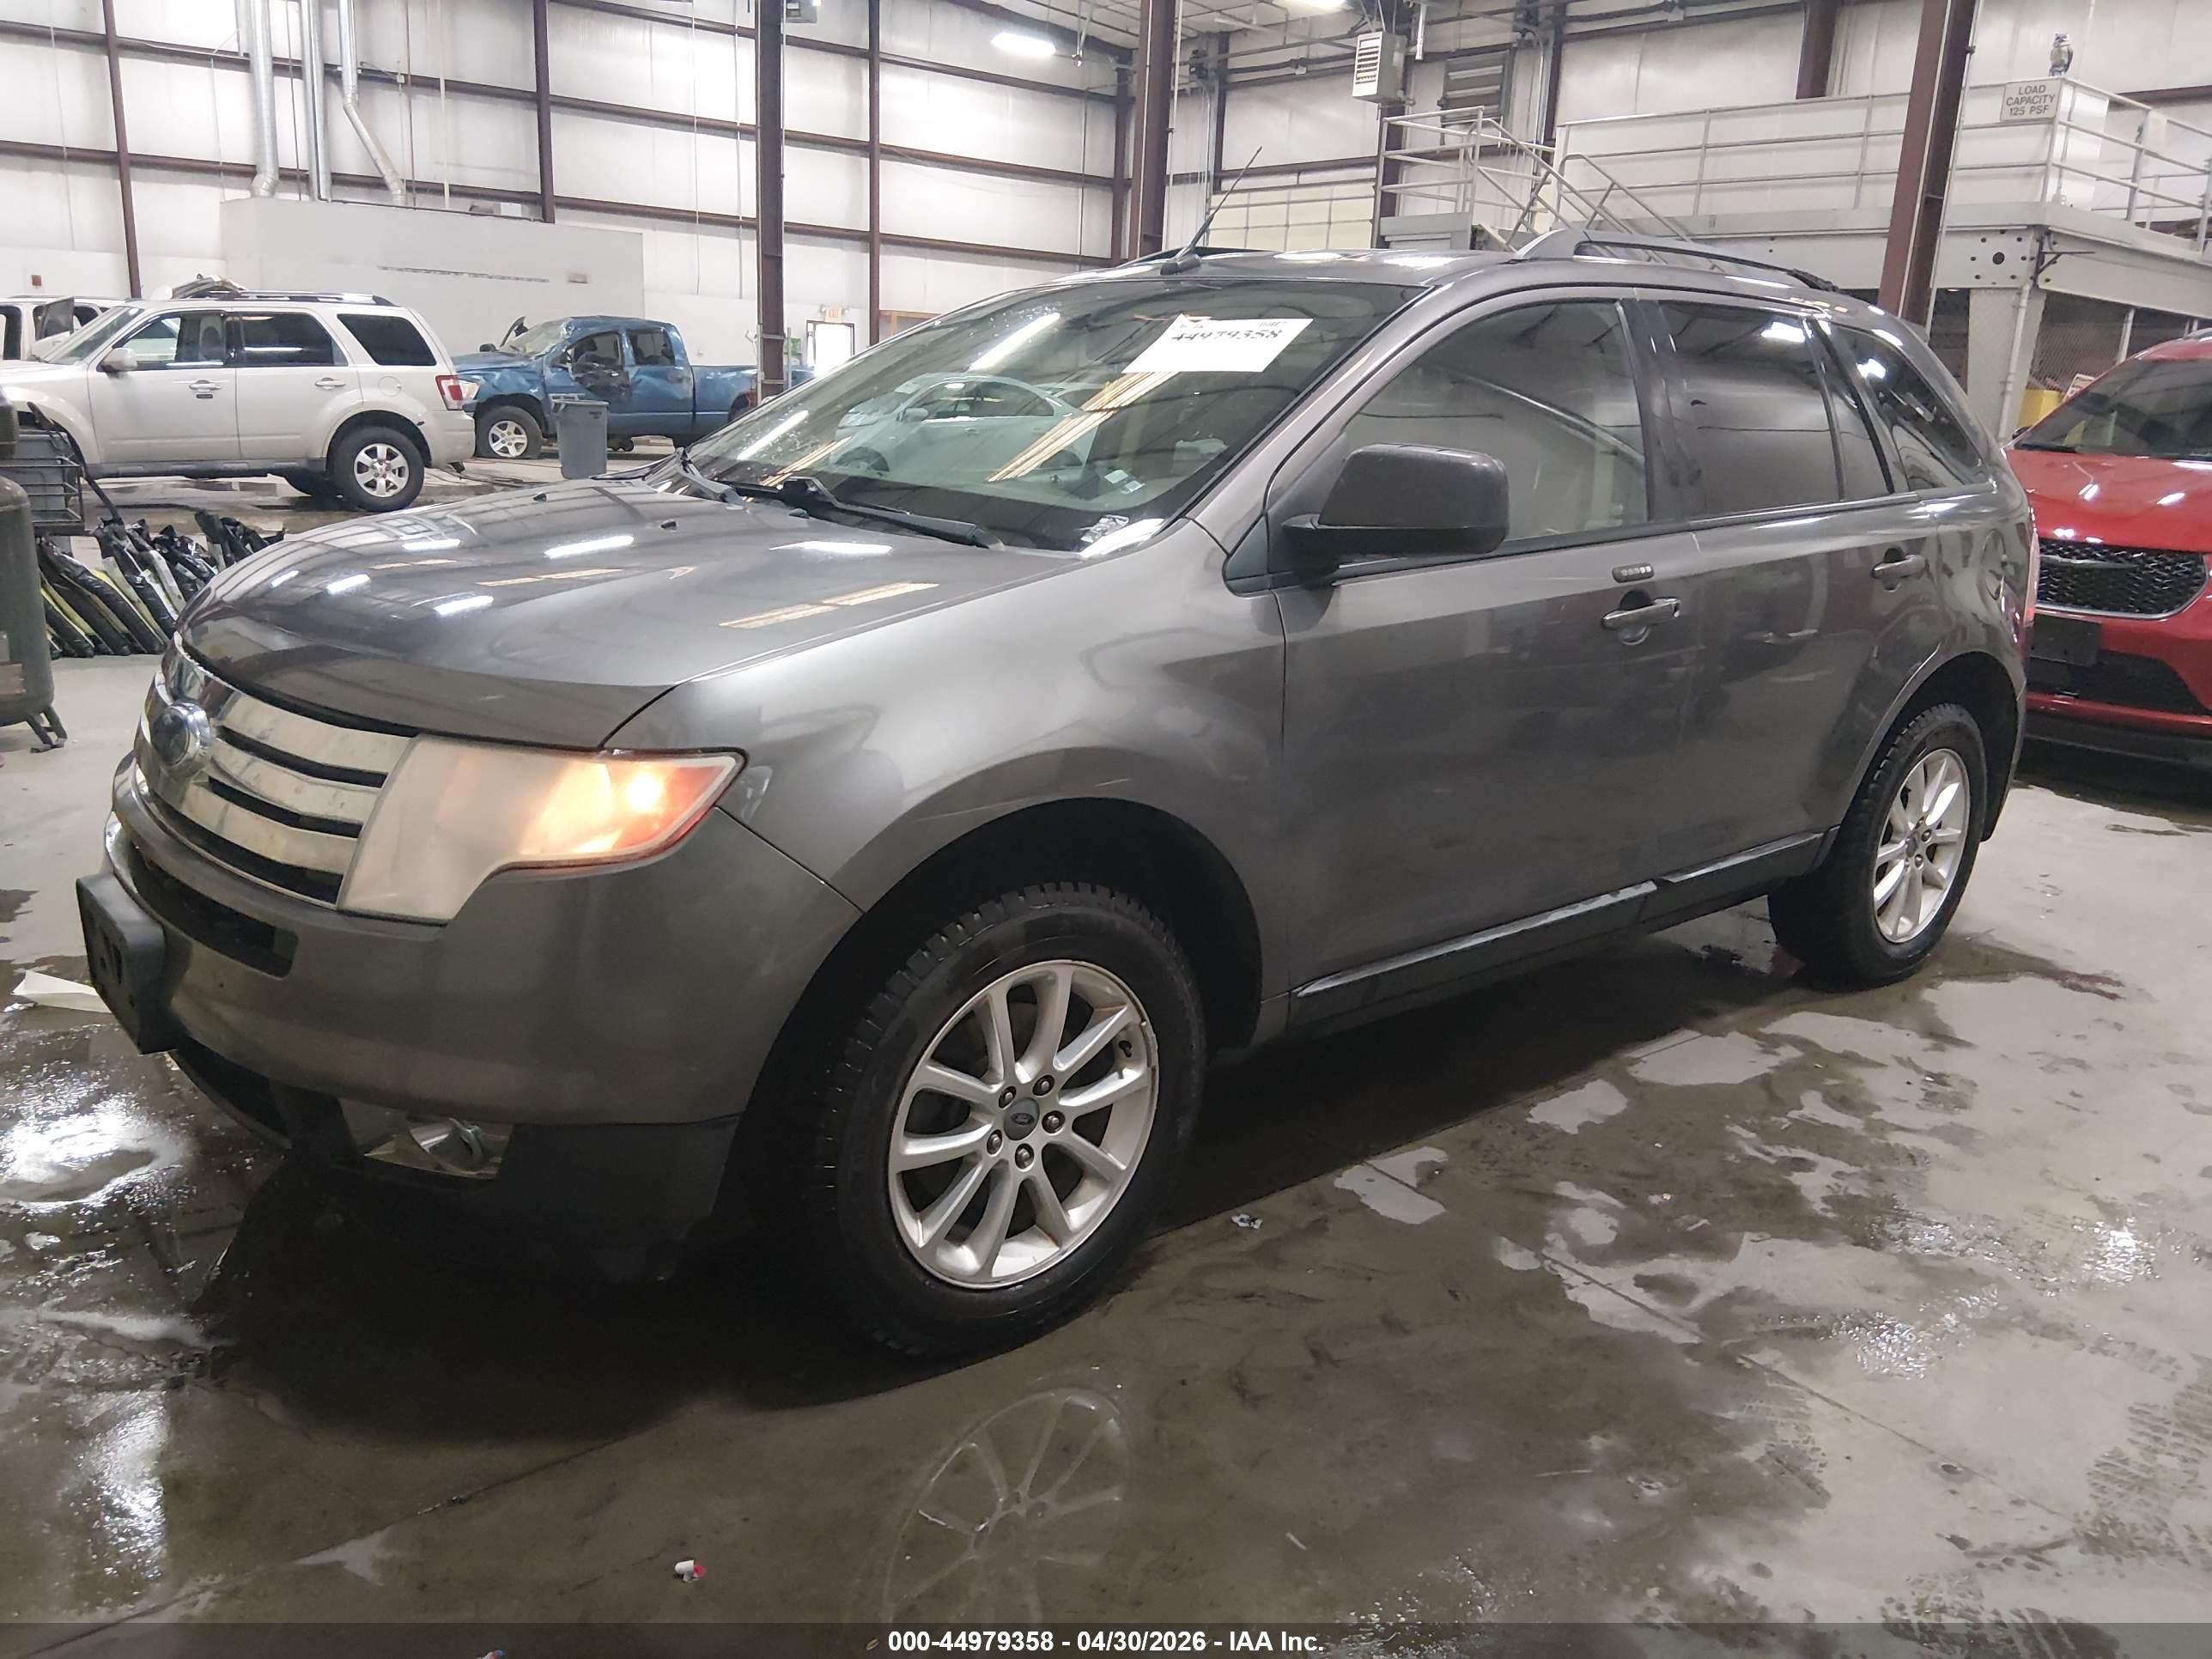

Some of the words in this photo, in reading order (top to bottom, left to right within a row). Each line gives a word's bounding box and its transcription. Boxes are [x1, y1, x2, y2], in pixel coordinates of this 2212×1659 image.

[2018, 85, 2046, 95] LOAD
[2006, 94, 2056, 106] CAPACITY
[2009, 106, 2026, 116] 125
[2029, 105, 2050, 114] PSF
